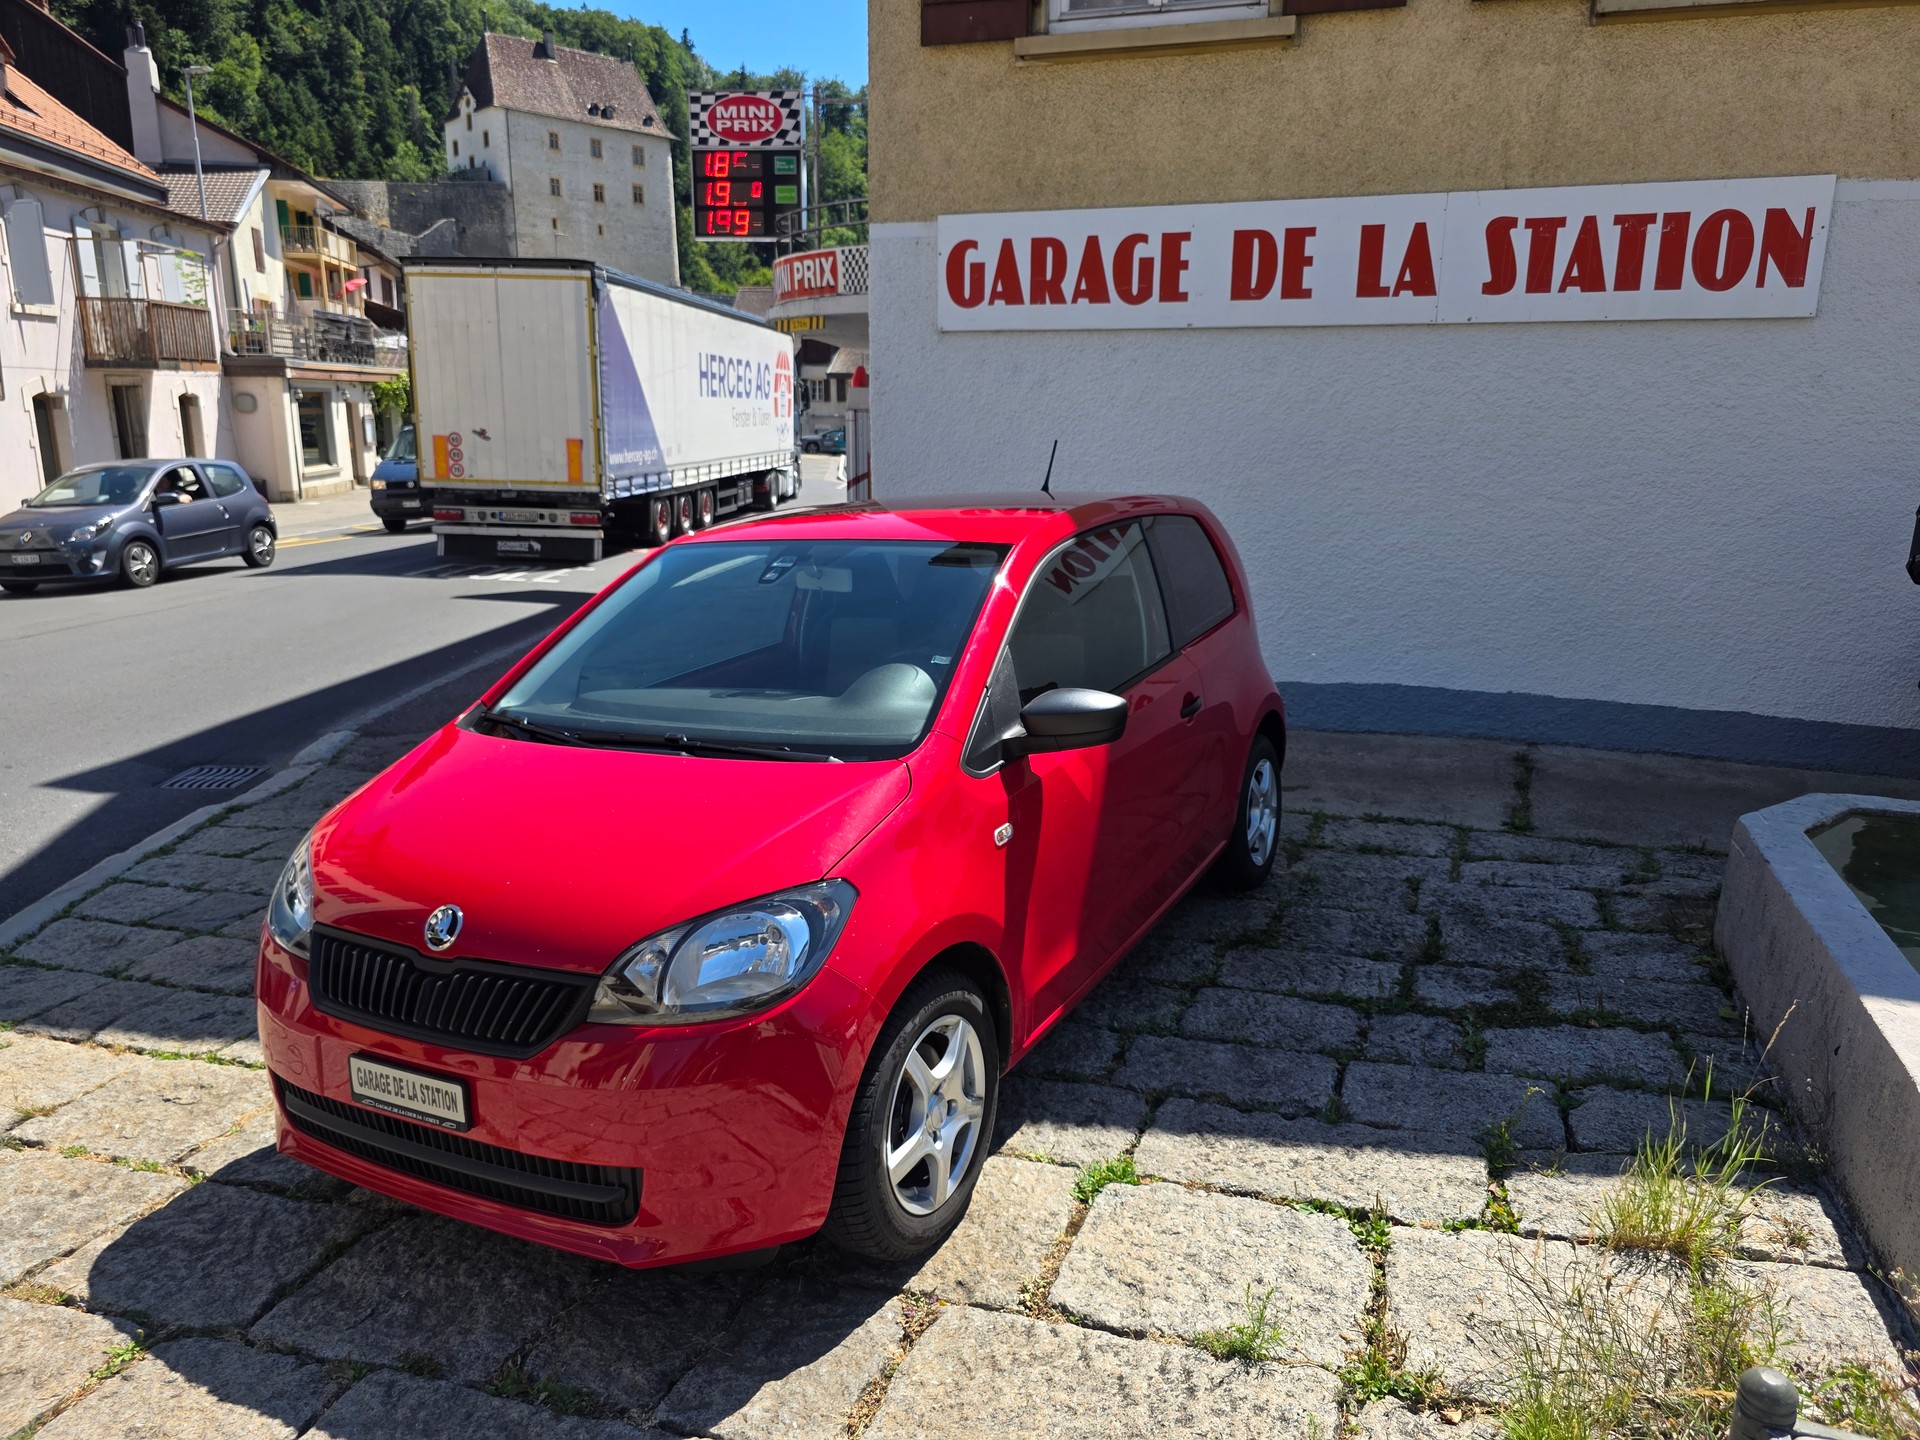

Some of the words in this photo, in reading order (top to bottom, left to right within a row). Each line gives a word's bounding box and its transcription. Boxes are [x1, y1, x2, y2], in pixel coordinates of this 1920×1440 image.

[716, 105, 775, 119] MINI
[716, 119, 775, 132] PRIX
[793, 256, 835, 291] PRIX
[945, 231, 1191, 309] GARAGE
[1230, 226, 1317, 301] DE
[1355, 221, 1437, 298] LA
[1481, 206, 1816, 295] STATION
[699, 352, 752, 399] HERCEG
[755, 362, 771, 400] AG
[356, 1066, 392, 1095] GARAGE
[393, 1076, 405, 1099] DE
[406, 1079, 419, 1103] LA
[420, 1082, 458, 1113] STATION
